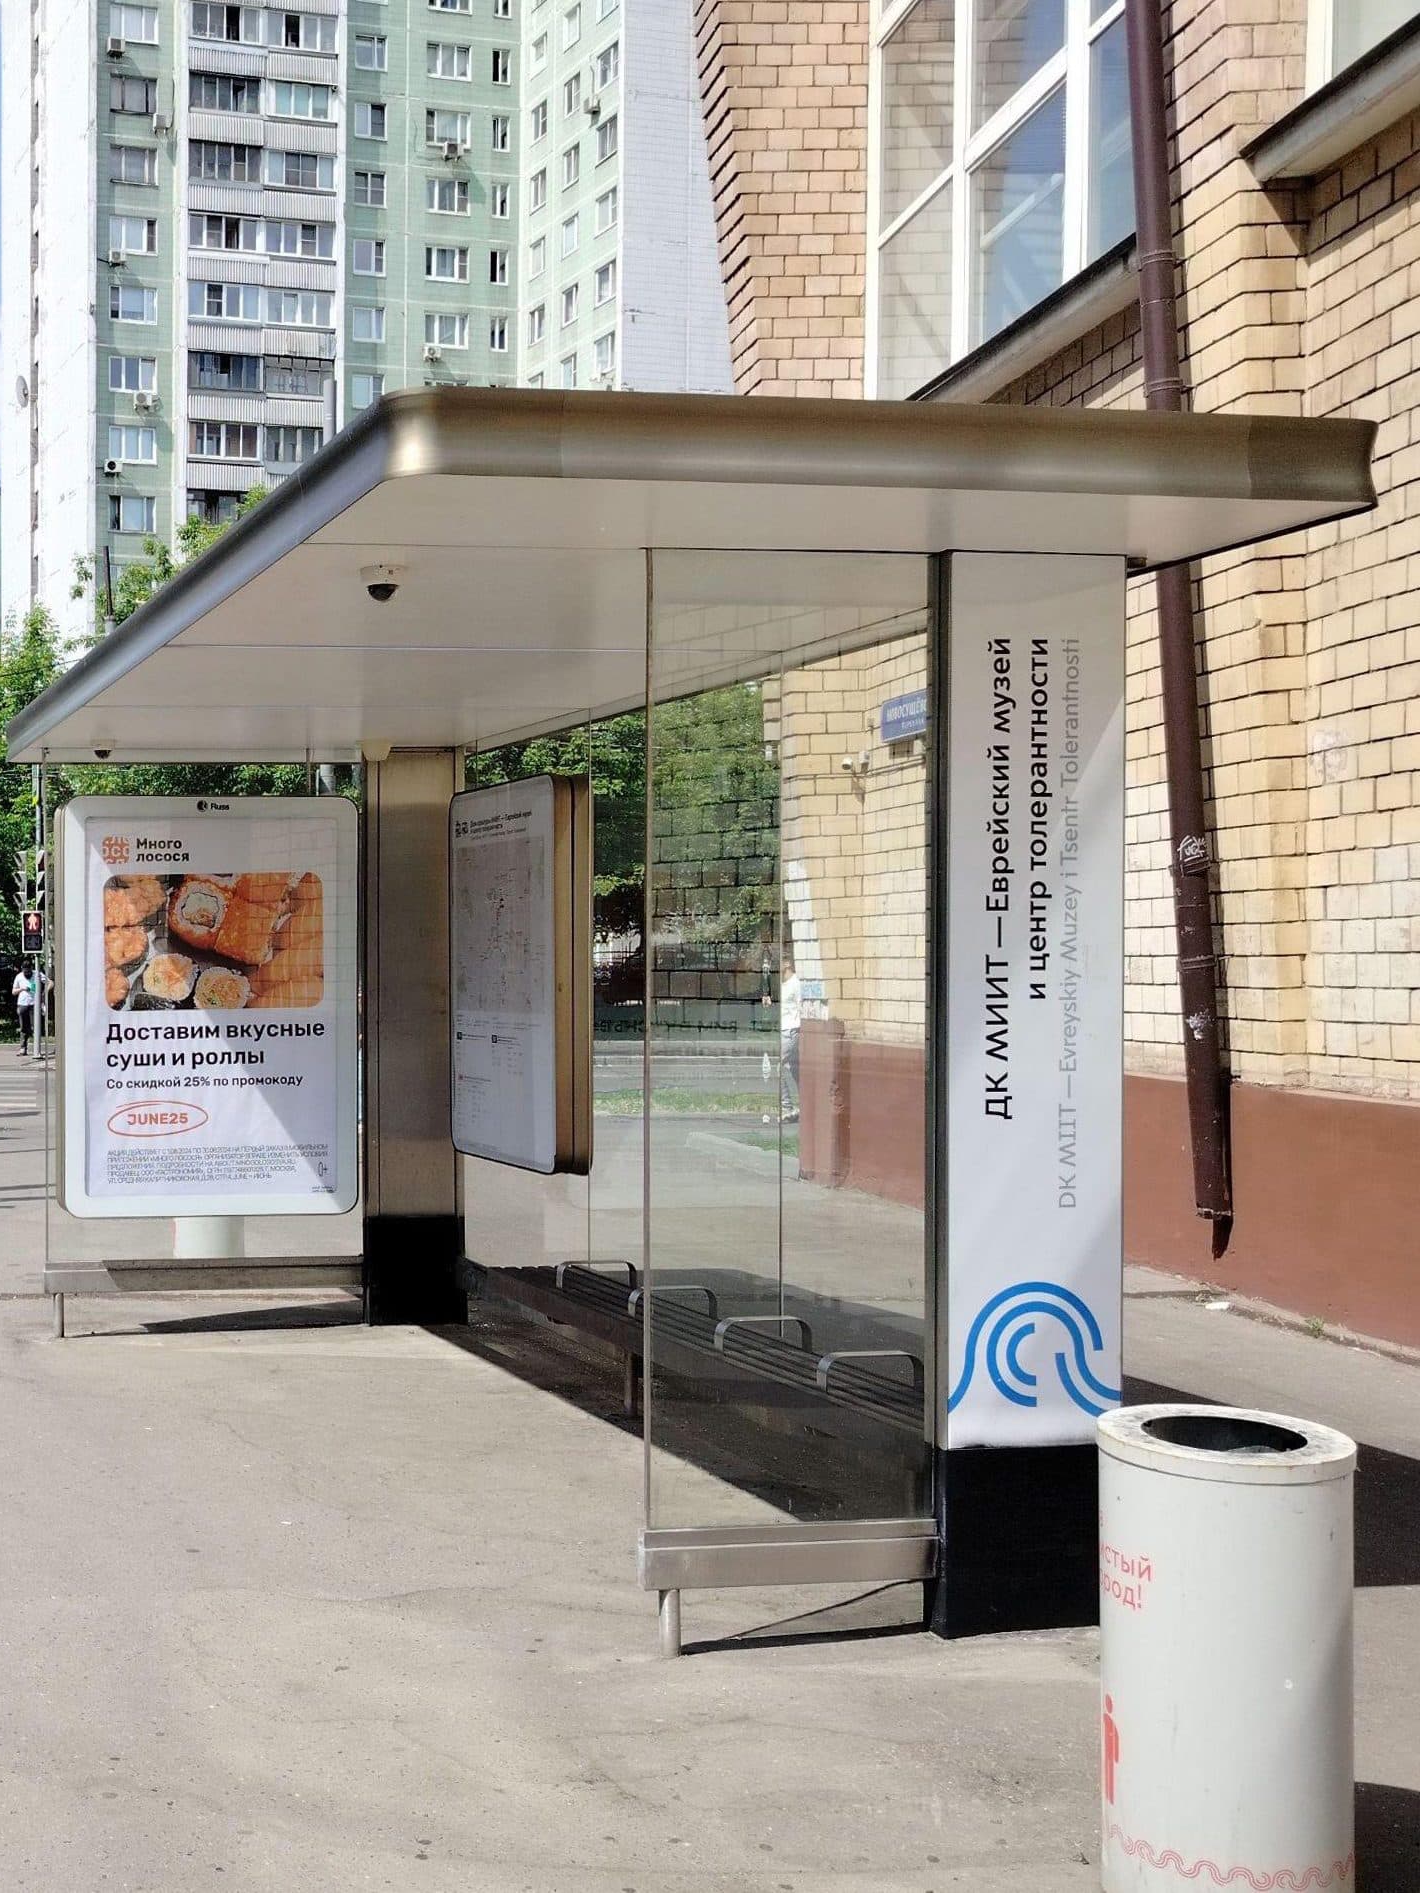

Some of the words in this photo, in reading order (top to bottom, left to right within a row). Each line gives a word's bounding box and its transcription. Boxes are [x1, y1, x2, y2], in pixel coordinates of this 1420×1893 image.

[987, 638, 1017, 734] музей
[1059, 638, 1081, 788] Tolerantnosti
[1029, 638, 1054, 872] толерантности
[136, 838, 182, 850] Много
[136, 852, 190, 862] лосося
[985, 744, 1016, 912] Еврейский
[1059, 796, 1079, 866] Tsentr
[1029, 880, 1053, 971] центр
[1059, 885, 1083, 962] Muzey
[984, 953, 1010, 1063] МИИТ
[1029, 982, 1047, 1000] и
[1058, 967, 1083, 1072] Evreyskiy
[106, 1023, 220, 1044] Доставим
[226, 1022, 325, 1042] вкусные
[106, 1053, 165, 1071] суши
[172, 1053, 185, 1066] и
[191, 1050, 265, 1069] роллы
[106, 1078, 123, 1089] Со
[126, 1076, 181, 1090] скидкой
[183, 1076, 210, 1087] 25%
[213, 1078, 229, 1087] по
[231, 1076, 303, 1088] промокоду
[983, 1071, 1013, 1121] ДК
[127, 1112, 189, 1126] JUNE25
[1058, 1103, 1078, 1168] MIIT
[1057, 1172, 1078, 1209] DK
